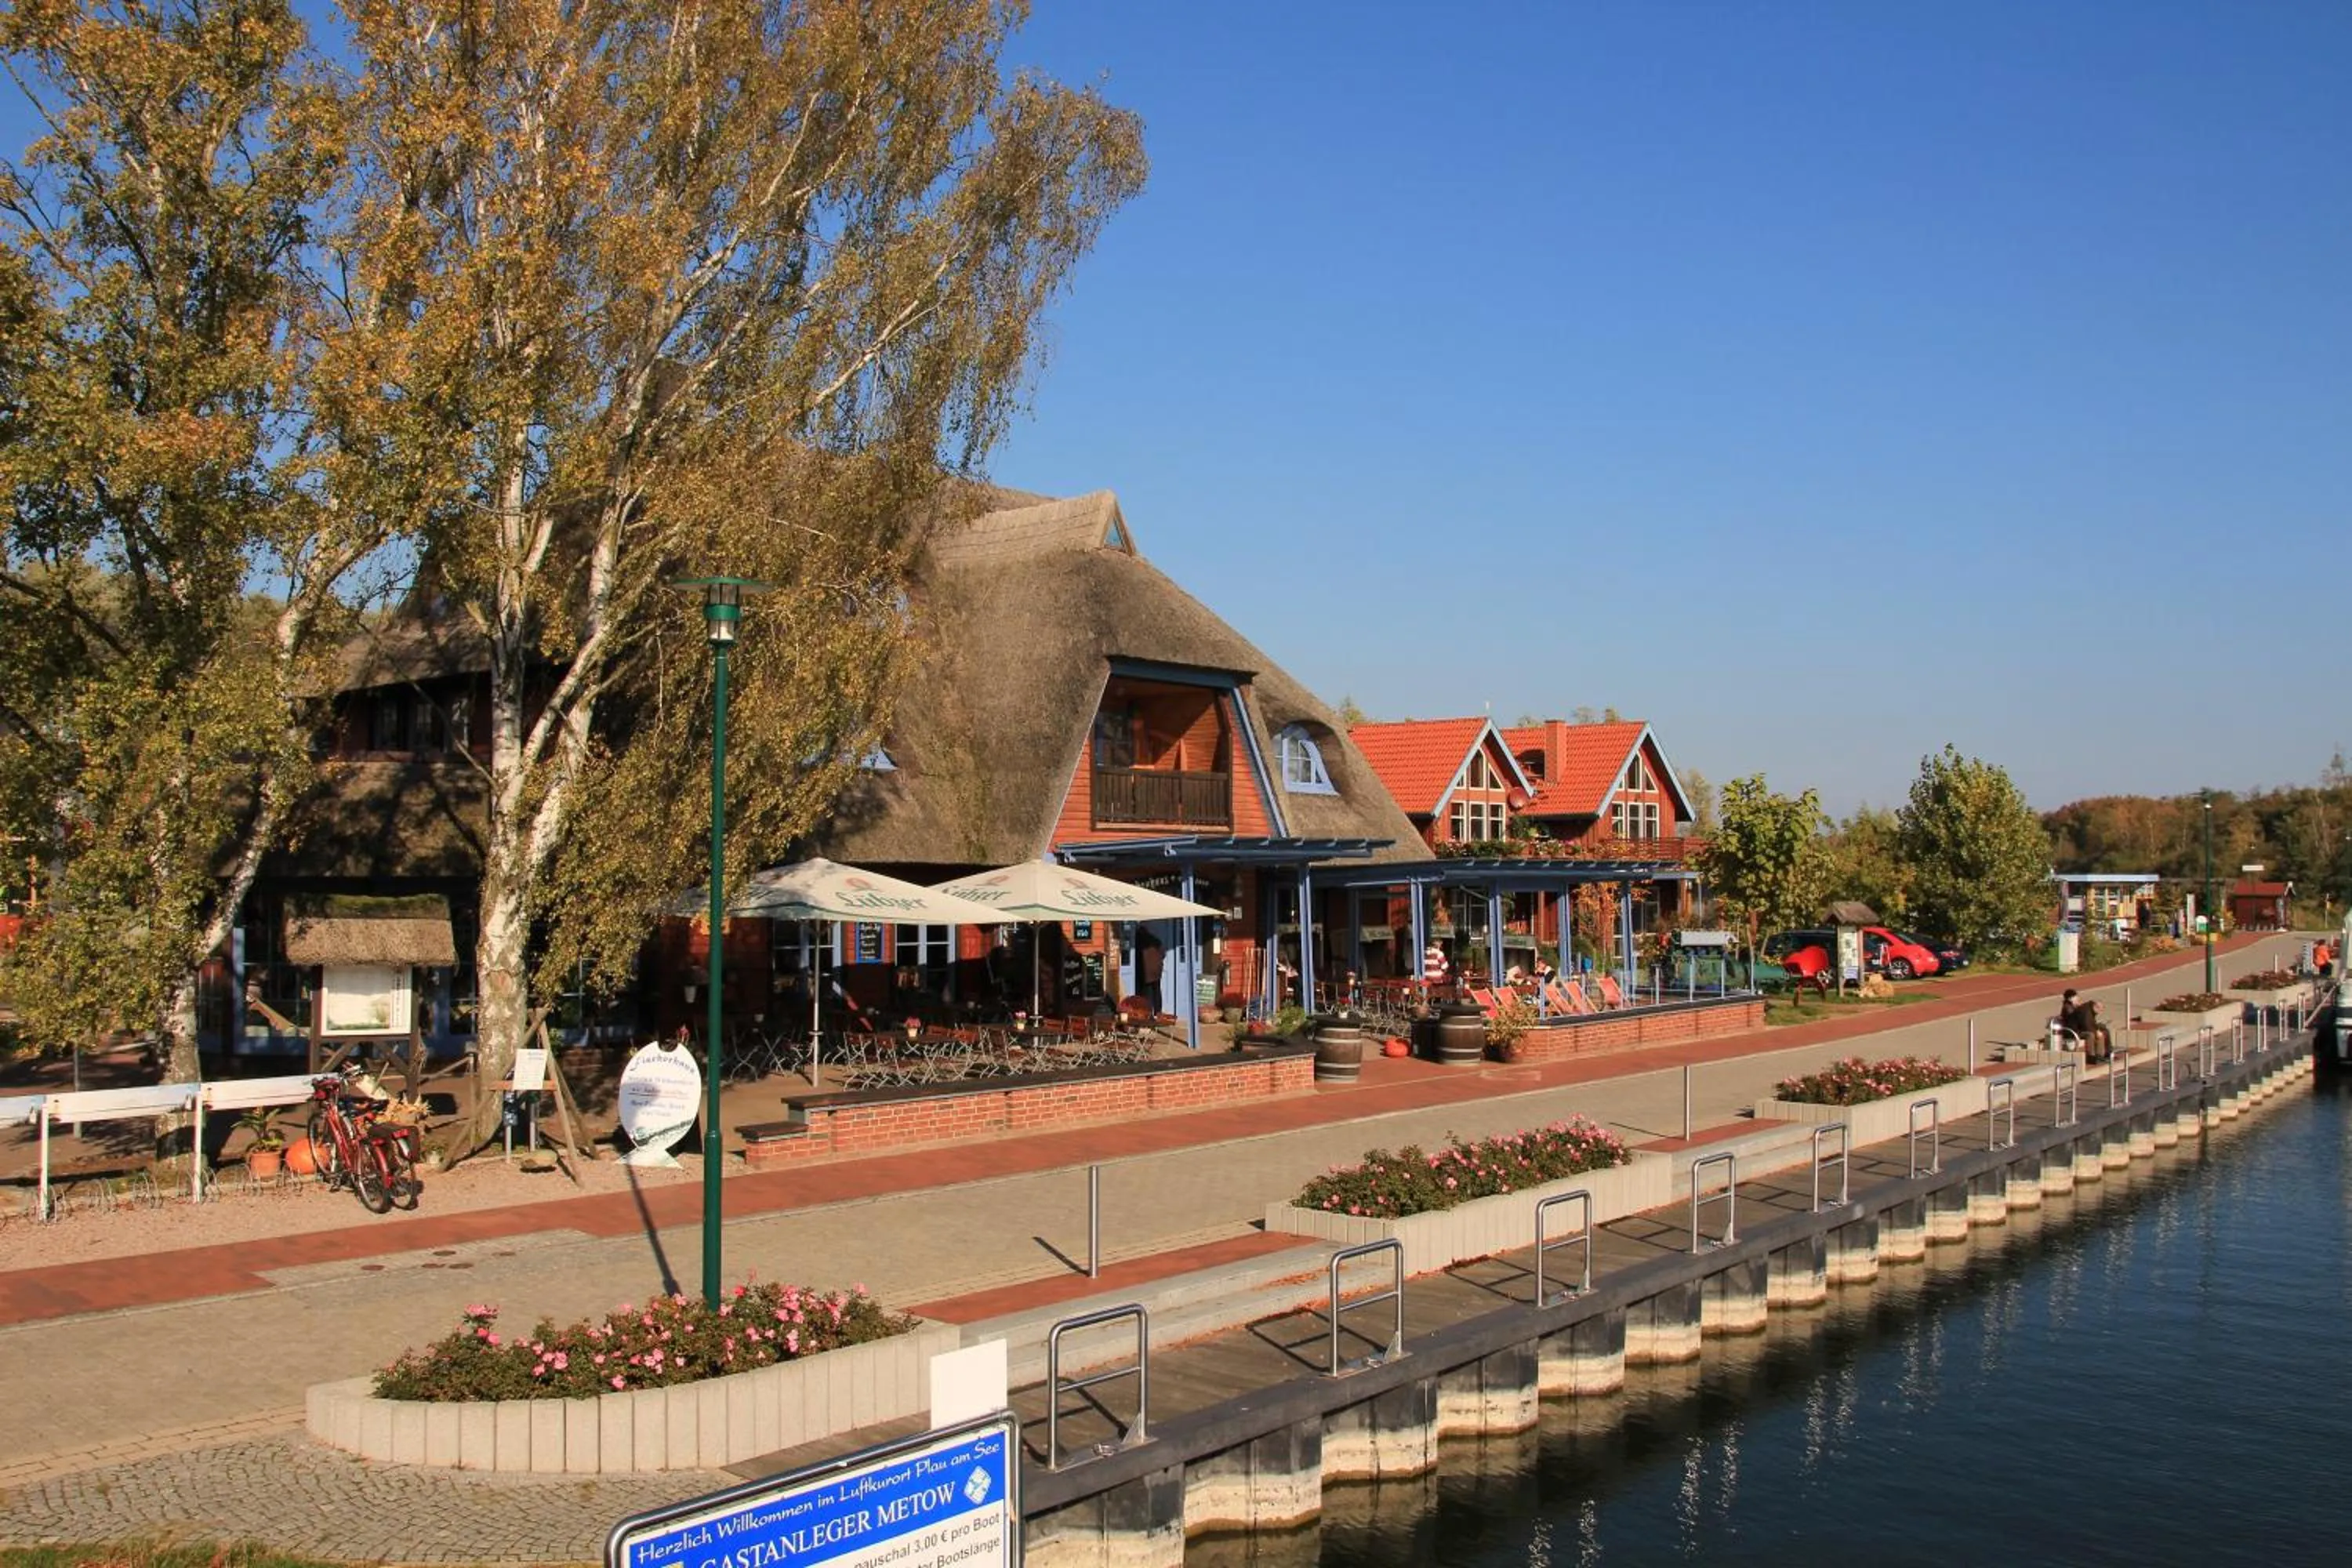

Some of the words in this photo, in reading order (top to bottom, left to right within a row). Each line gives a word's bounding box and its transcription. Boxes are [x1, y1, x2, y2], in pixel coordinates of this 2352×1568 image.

[835, 891, 928, 910] Lübzer
[637, 1527, 713, 1564] Herzlich
[717, 1501, 813, 1538] Willkommen
[818, 1494, 834, 1508] im
[840, 1468, 911, 1501] Luftkurort
[916, 1458, 947, 1478] Plau
[951, 1453, 971, 1466] am
[973, 1441, 1000, 1459] See
[877, 1481, 956, 1527] METOW
[914, 1534, 938, 1552] 3,00
[941, 1530, 948, 1542] €
[951, 1526, 970, 1542] pro
[973, 1513, 1000, 1530] Boot
[937, 1537, 1000, 1568] Bootslänge
